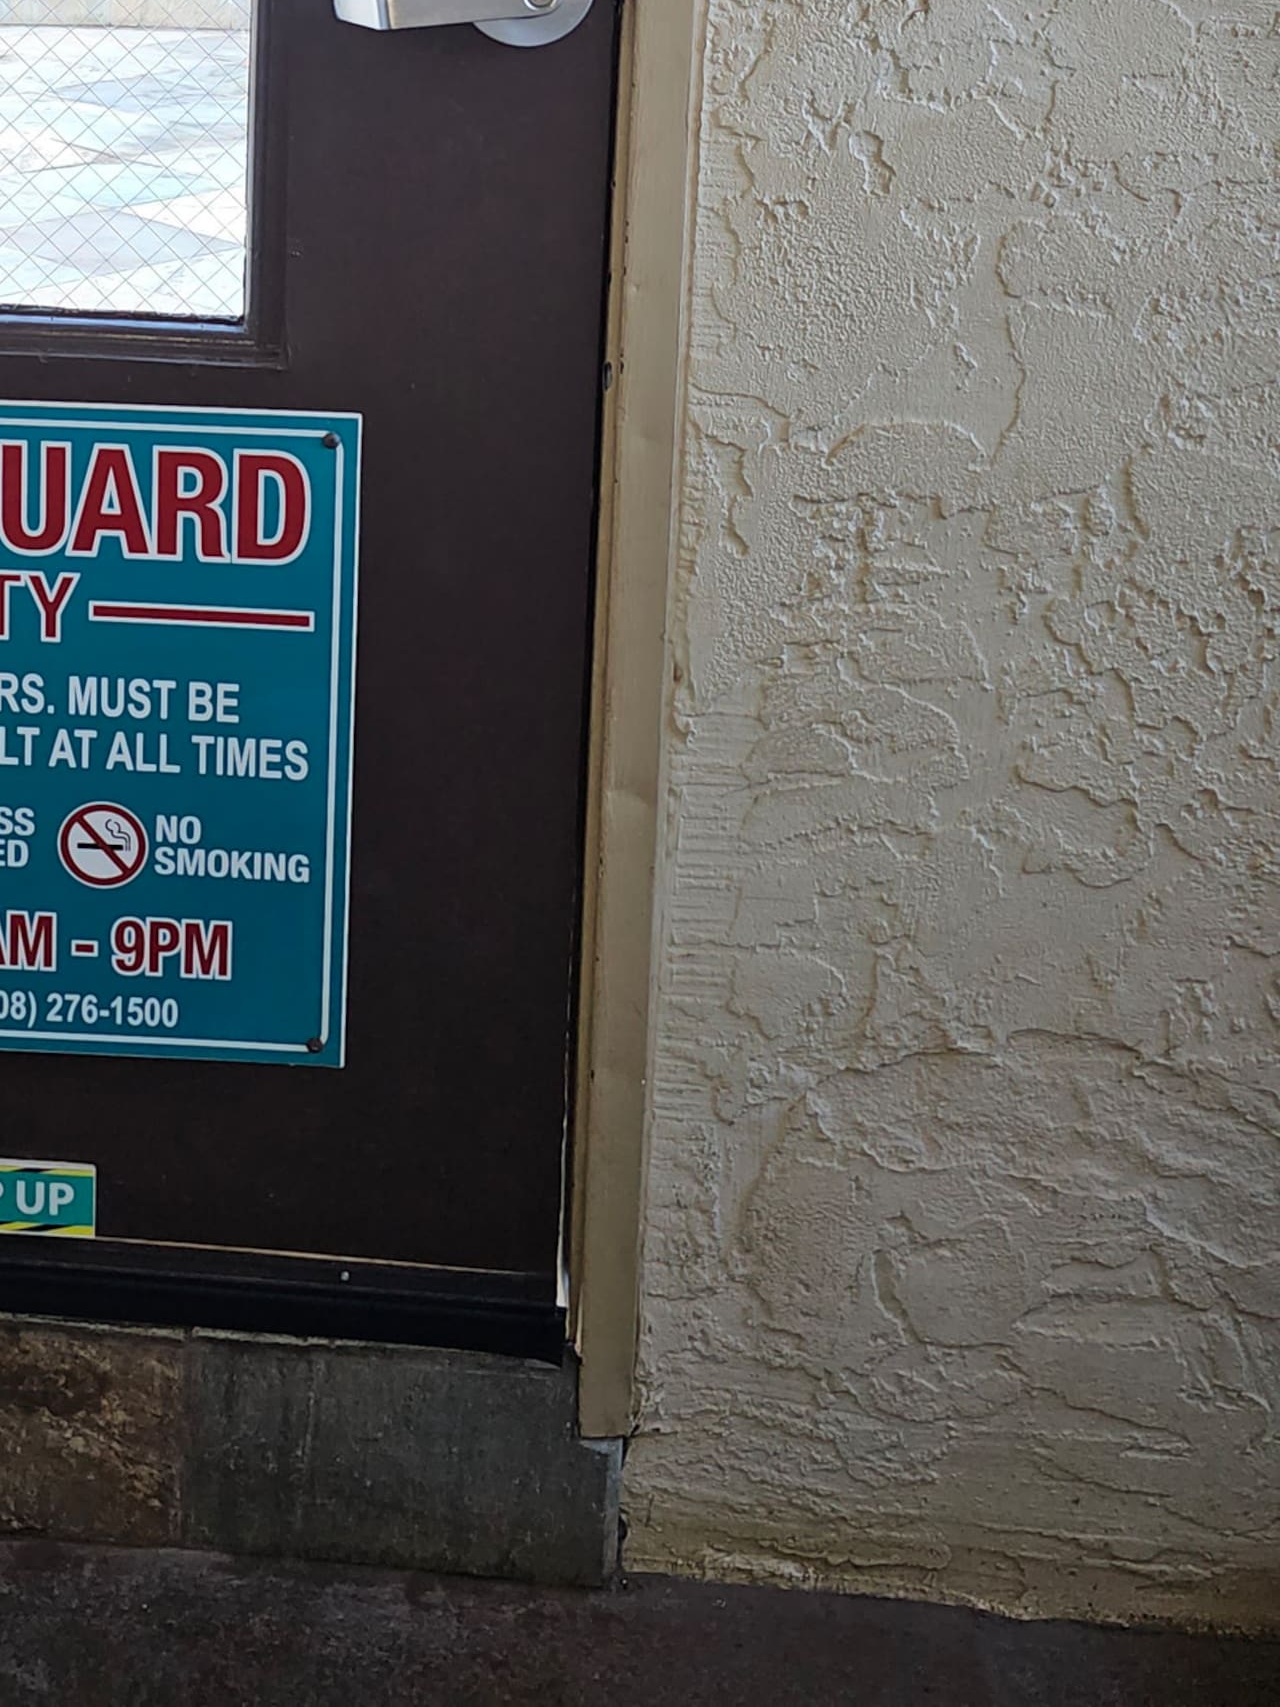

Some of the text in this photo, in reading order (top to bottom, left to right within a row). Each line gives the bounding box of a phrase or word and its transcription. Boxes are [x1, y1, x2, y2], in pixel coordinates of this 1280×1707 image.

[69, 676, 176, 719] MUST
[189, 682, 239, 722] BE
[49, 729, 97, 768] AT
[106, 732, 180, 773] ALL
[196, 736, 308, 780] TIMES
[156, 815, 201, 844] NO
[155, 847, 309, 882] SMOKING
[71, 940, 98, 956] -
[111, 917, 232, 980] 9PM
[47, 993, 177, 1027] 276-1500
[16, 1180, 75, 1216] UP
